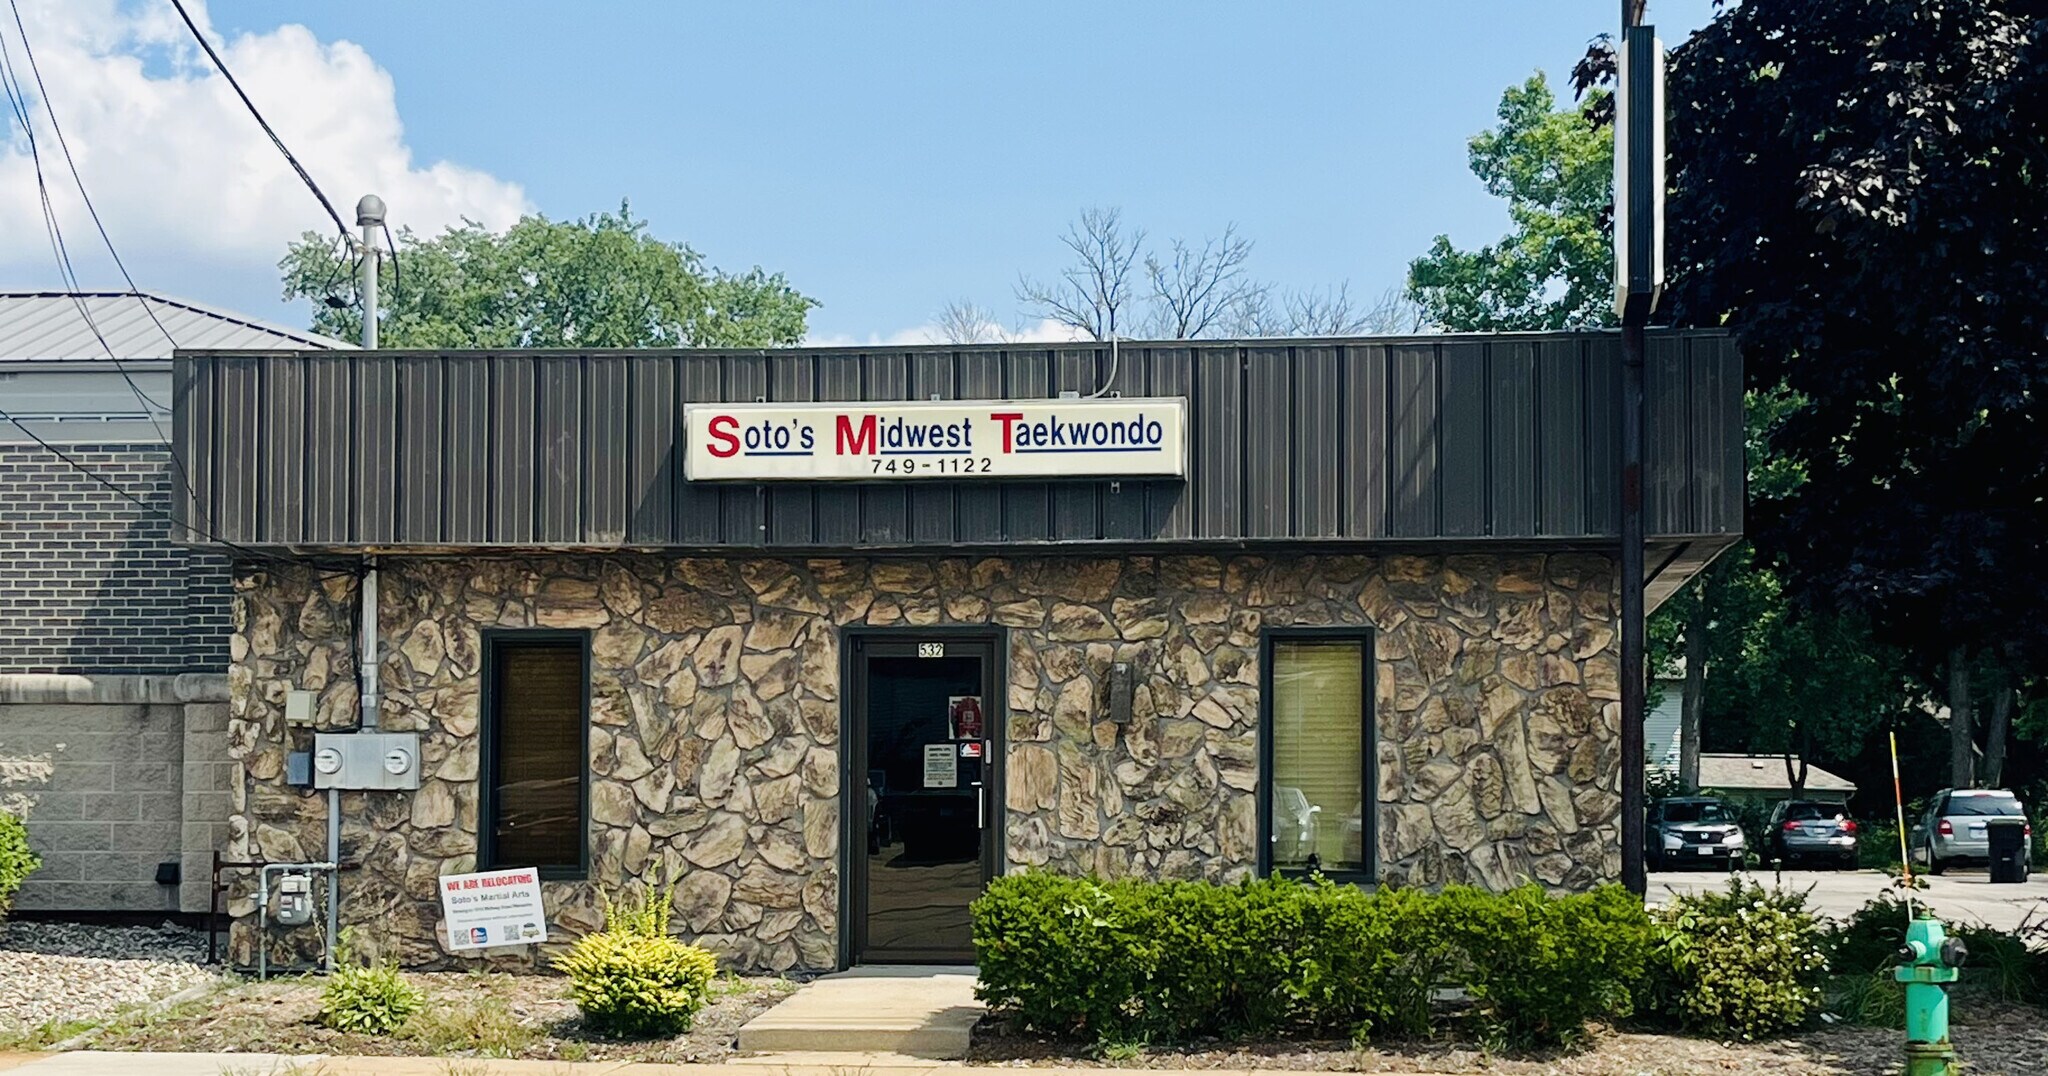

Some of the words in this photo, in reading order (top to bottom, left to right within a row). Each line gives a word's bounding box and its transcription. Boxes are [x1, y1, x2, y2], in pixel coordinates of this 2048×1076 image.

[706, 415, 814, 457] Soto's
[836, 414, 971, 455] Midwest
[990, 413, 1162, 454] Taekwondo
[871, 457, 992, 474] 749-1122
[447, 881, 460, 891] WE
[463, 879, 479, 890] ARE
[481, 874, 533, 887] RELOCATING
